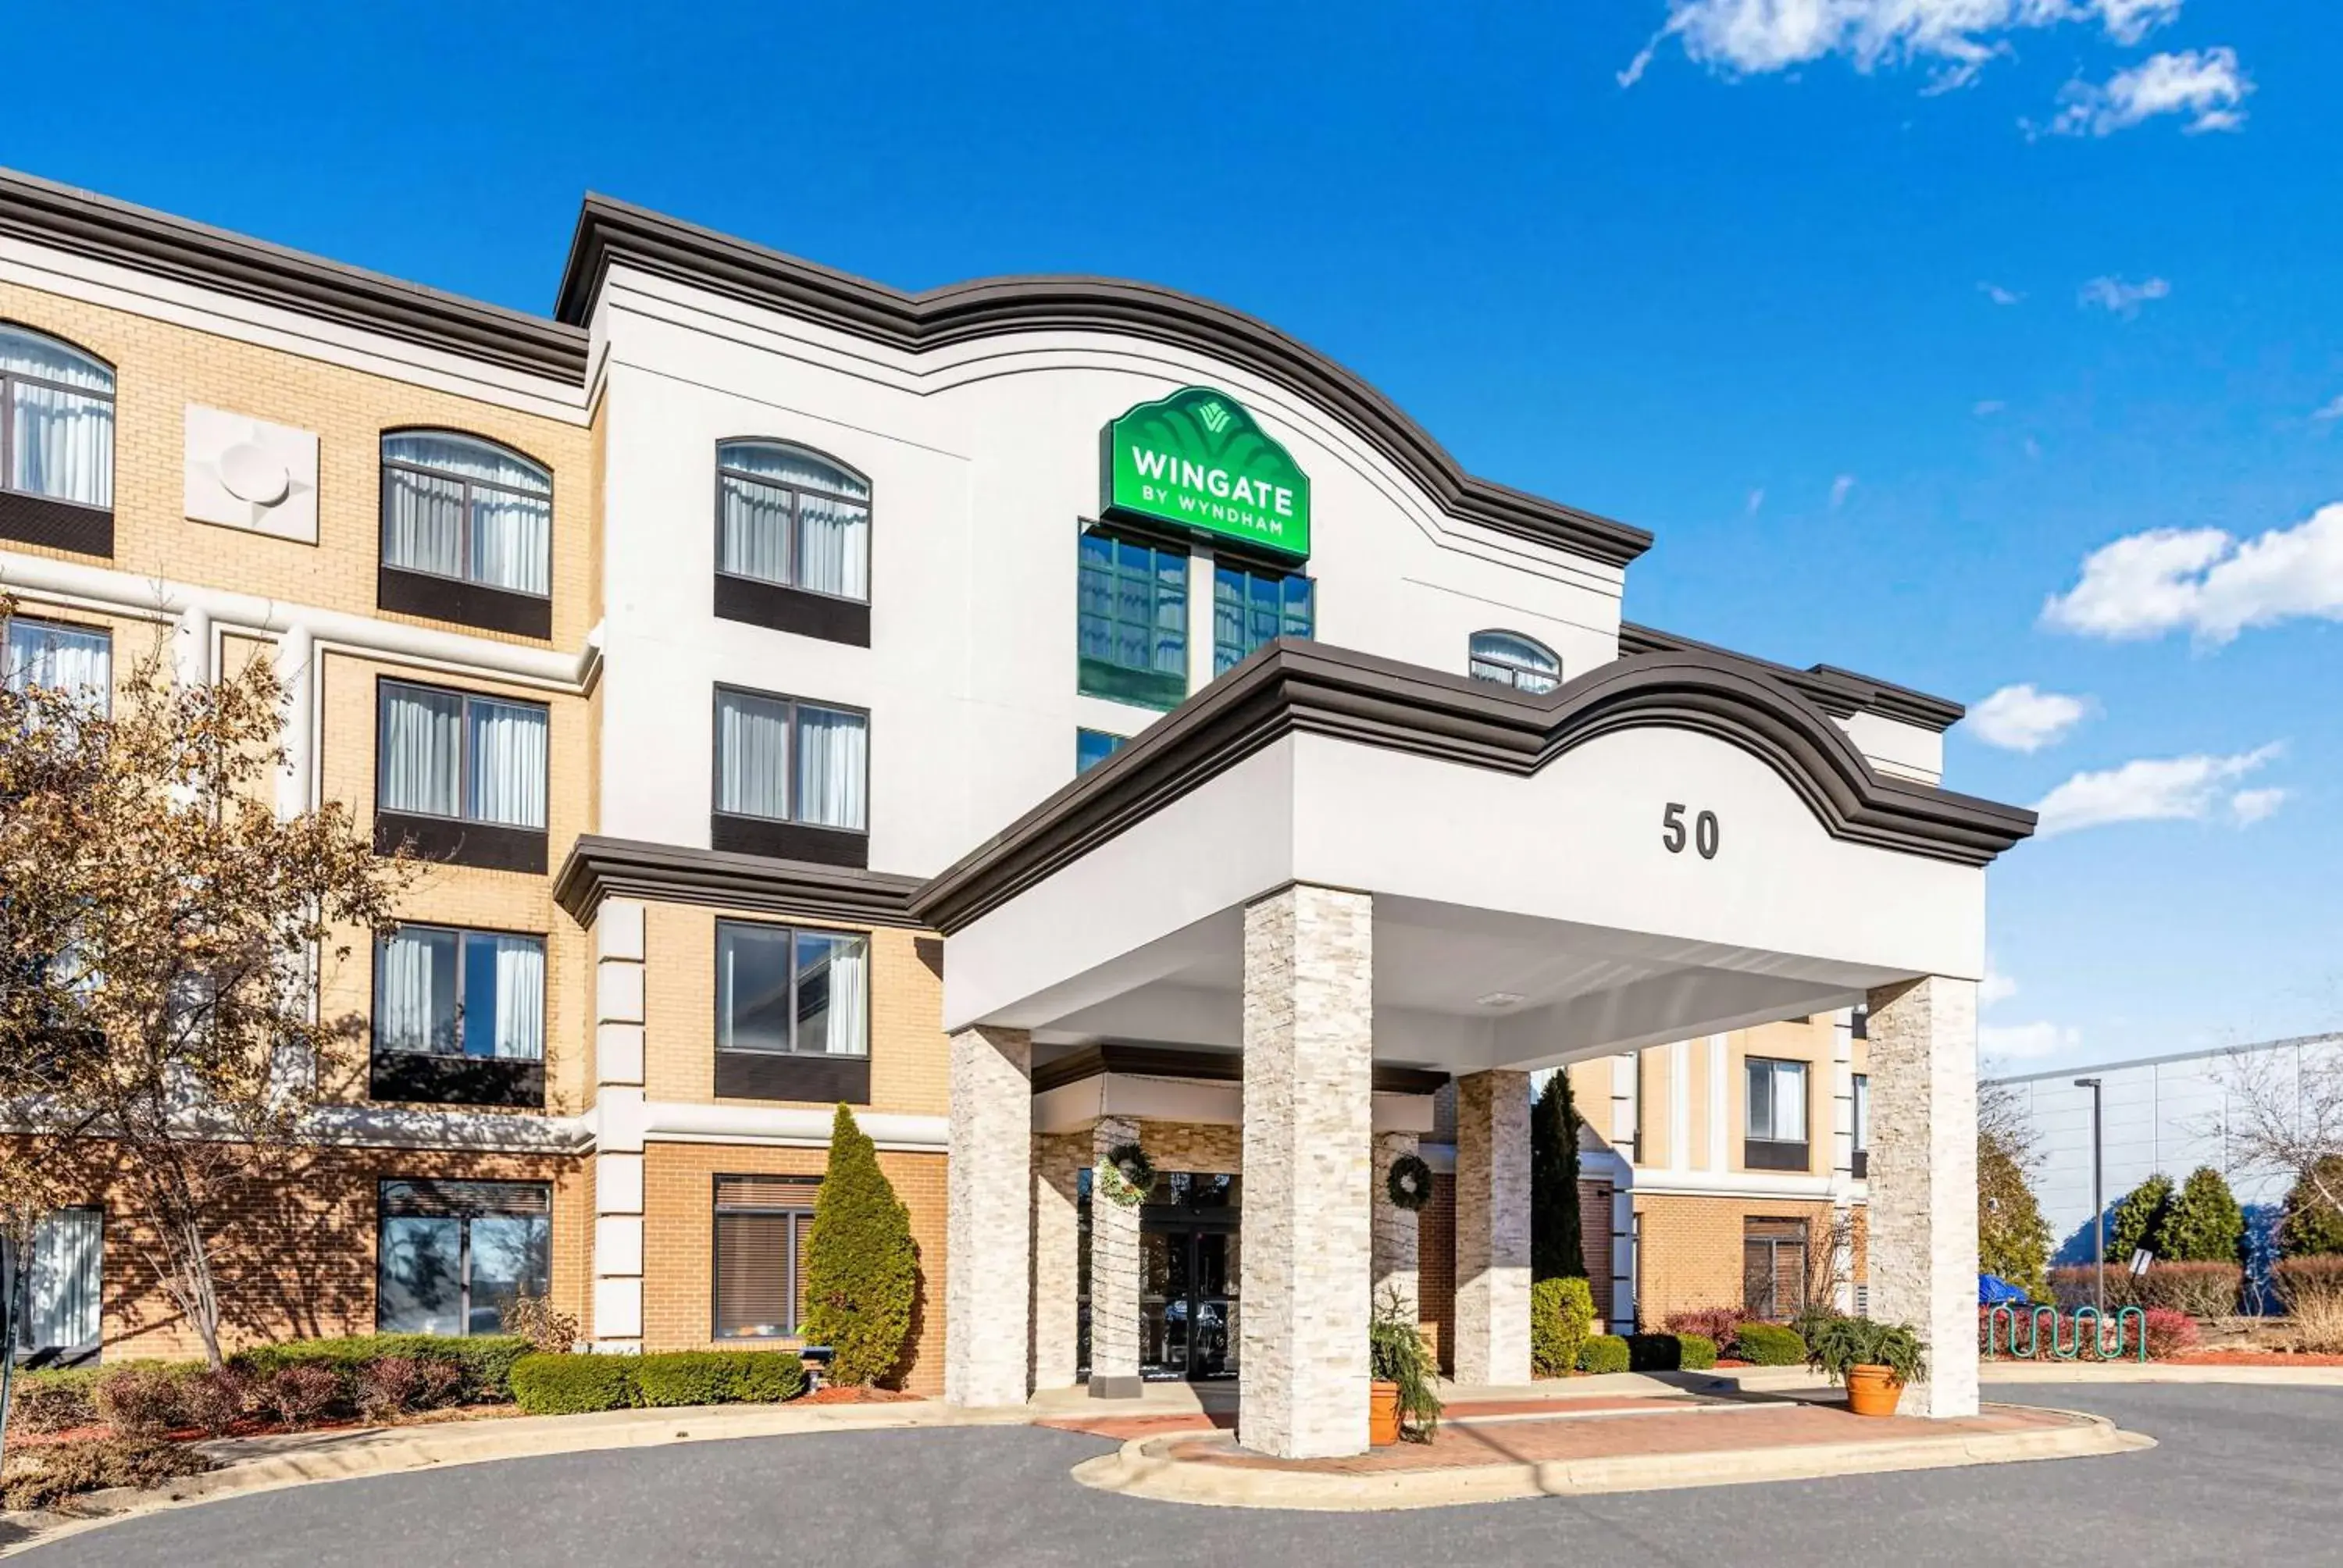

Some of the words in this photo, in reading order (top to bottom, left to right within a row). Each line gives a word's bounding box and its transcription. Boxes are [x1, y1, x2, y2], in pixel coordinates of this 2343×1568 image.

[1132, 446, 1293, 517] WINGATE
[1142, 485, 1168, 504] BY
[1178, 494, 1283, 536] WYNDHAM
[1663, 802, 1719, 860] 50
